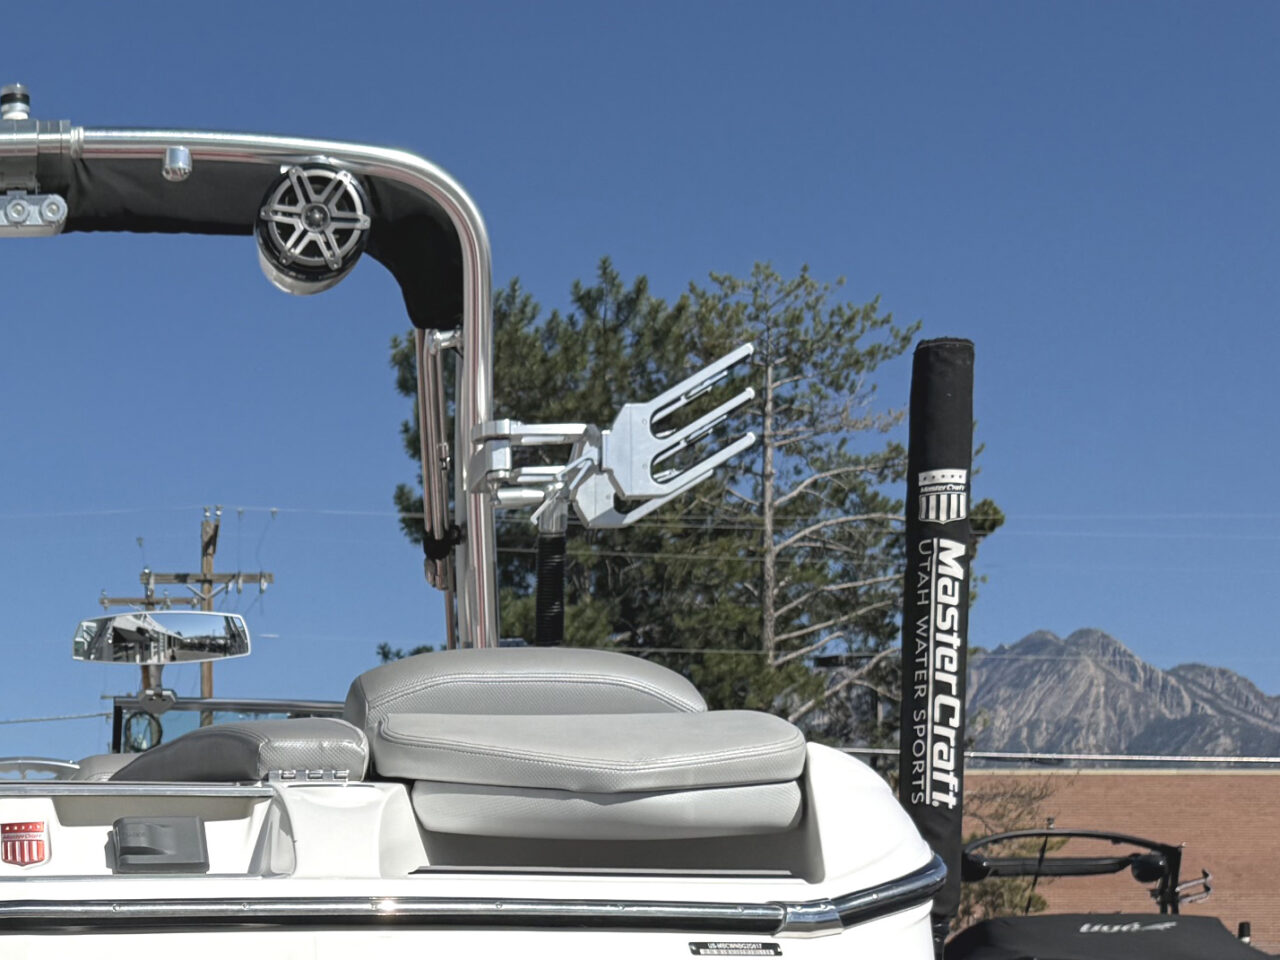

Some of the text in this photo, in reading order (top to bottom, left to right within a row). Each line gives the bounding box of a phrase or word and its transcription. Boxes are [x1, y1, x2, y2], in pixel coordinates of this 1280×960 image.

[911, 539, 932, 804] UTAH WATER SPORTS
[932, 538, 966, 810] MasterCraft
